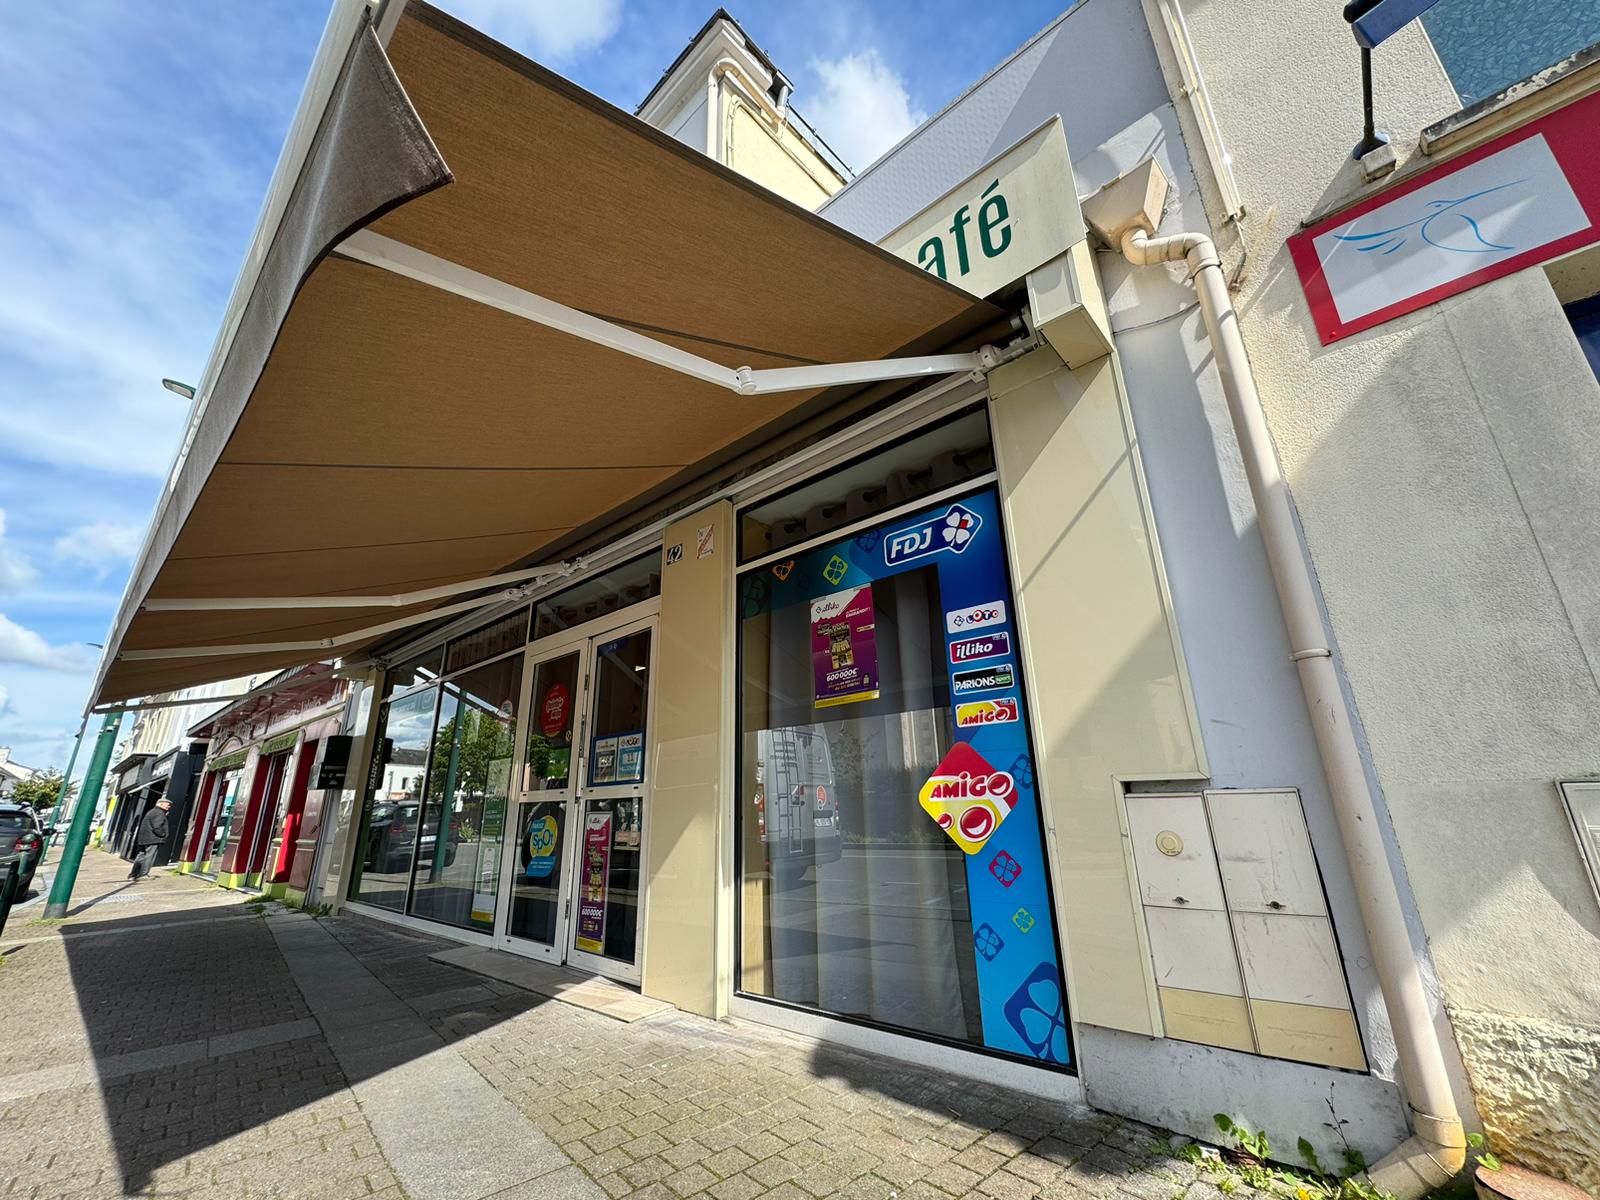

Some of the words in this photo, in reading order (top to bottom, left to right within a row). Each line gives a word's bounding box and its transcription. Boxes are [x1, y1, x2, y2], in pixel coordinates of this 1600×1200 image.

[891, 527, 932, 558] FDJ
[667, 544, 682, 563] 42
[966, 610, 999, 624] LOTO
[956, 643, 993, 658] illiko
[955, 676, 995, 690] PARIONS
